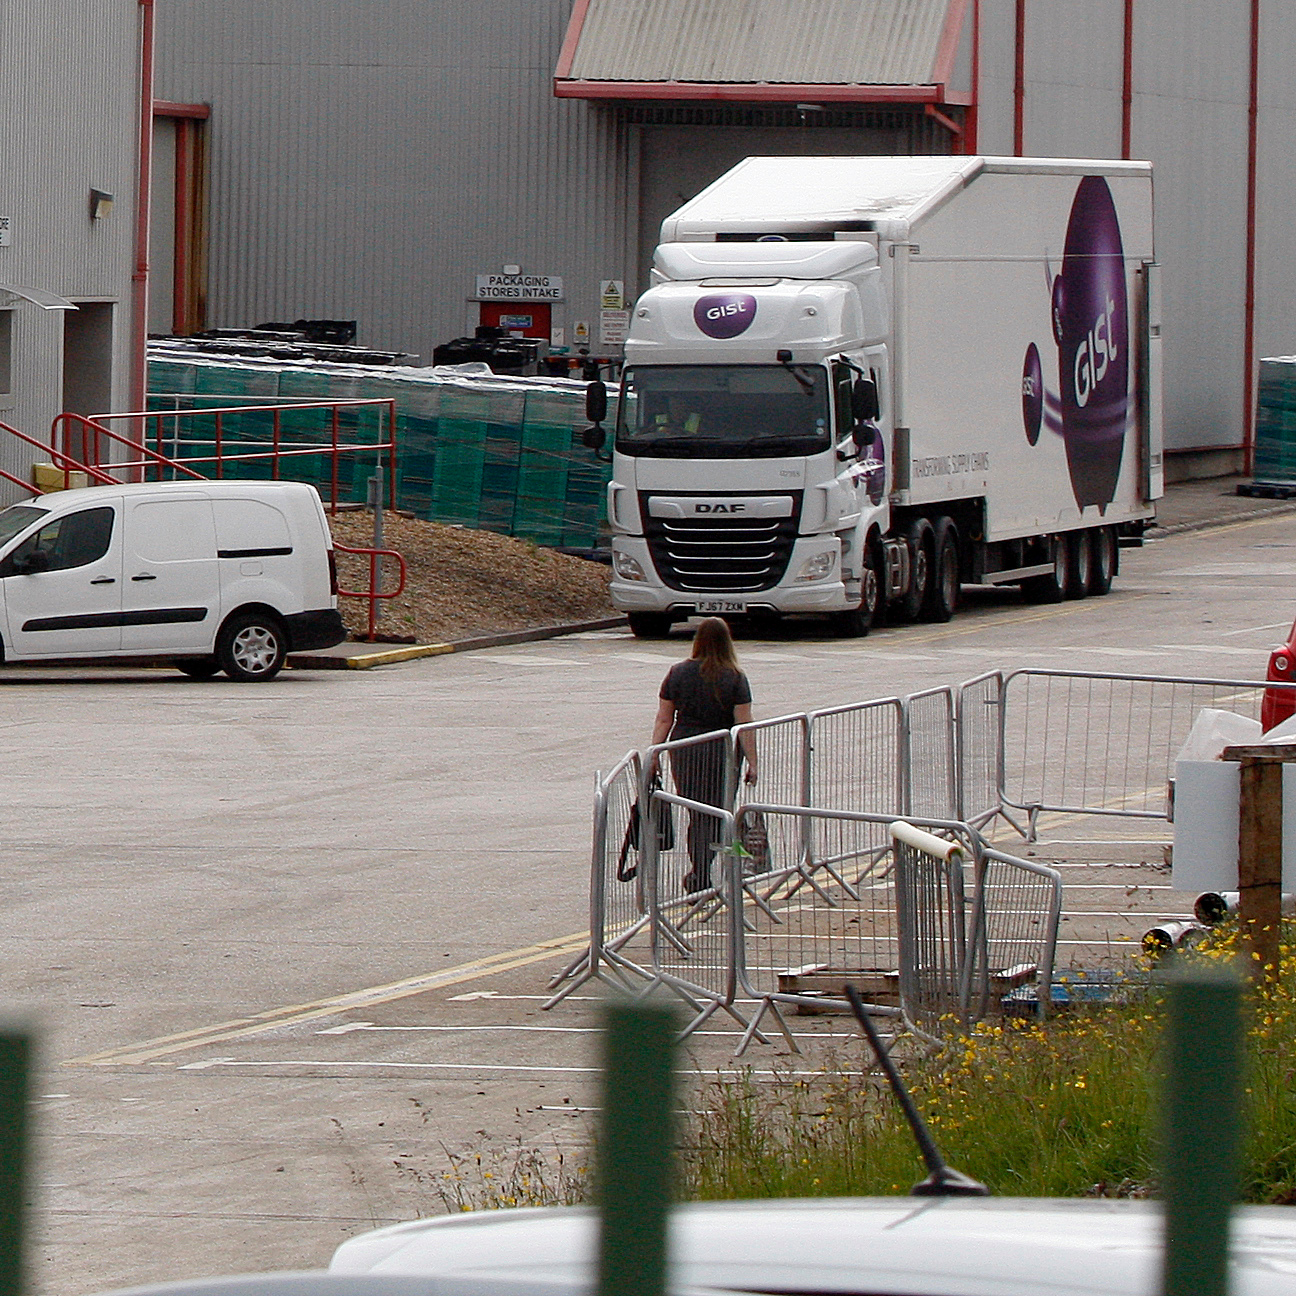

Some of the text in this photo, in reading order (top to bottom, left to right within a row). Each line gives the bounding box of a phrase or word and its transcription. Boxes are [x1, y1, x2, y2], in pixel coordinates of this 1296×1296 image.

[488, 276, 550, 287] PACKAGING
[479, 287, 560, 298] STORES INTAKE
[694, 503, 746, 514] DAF
